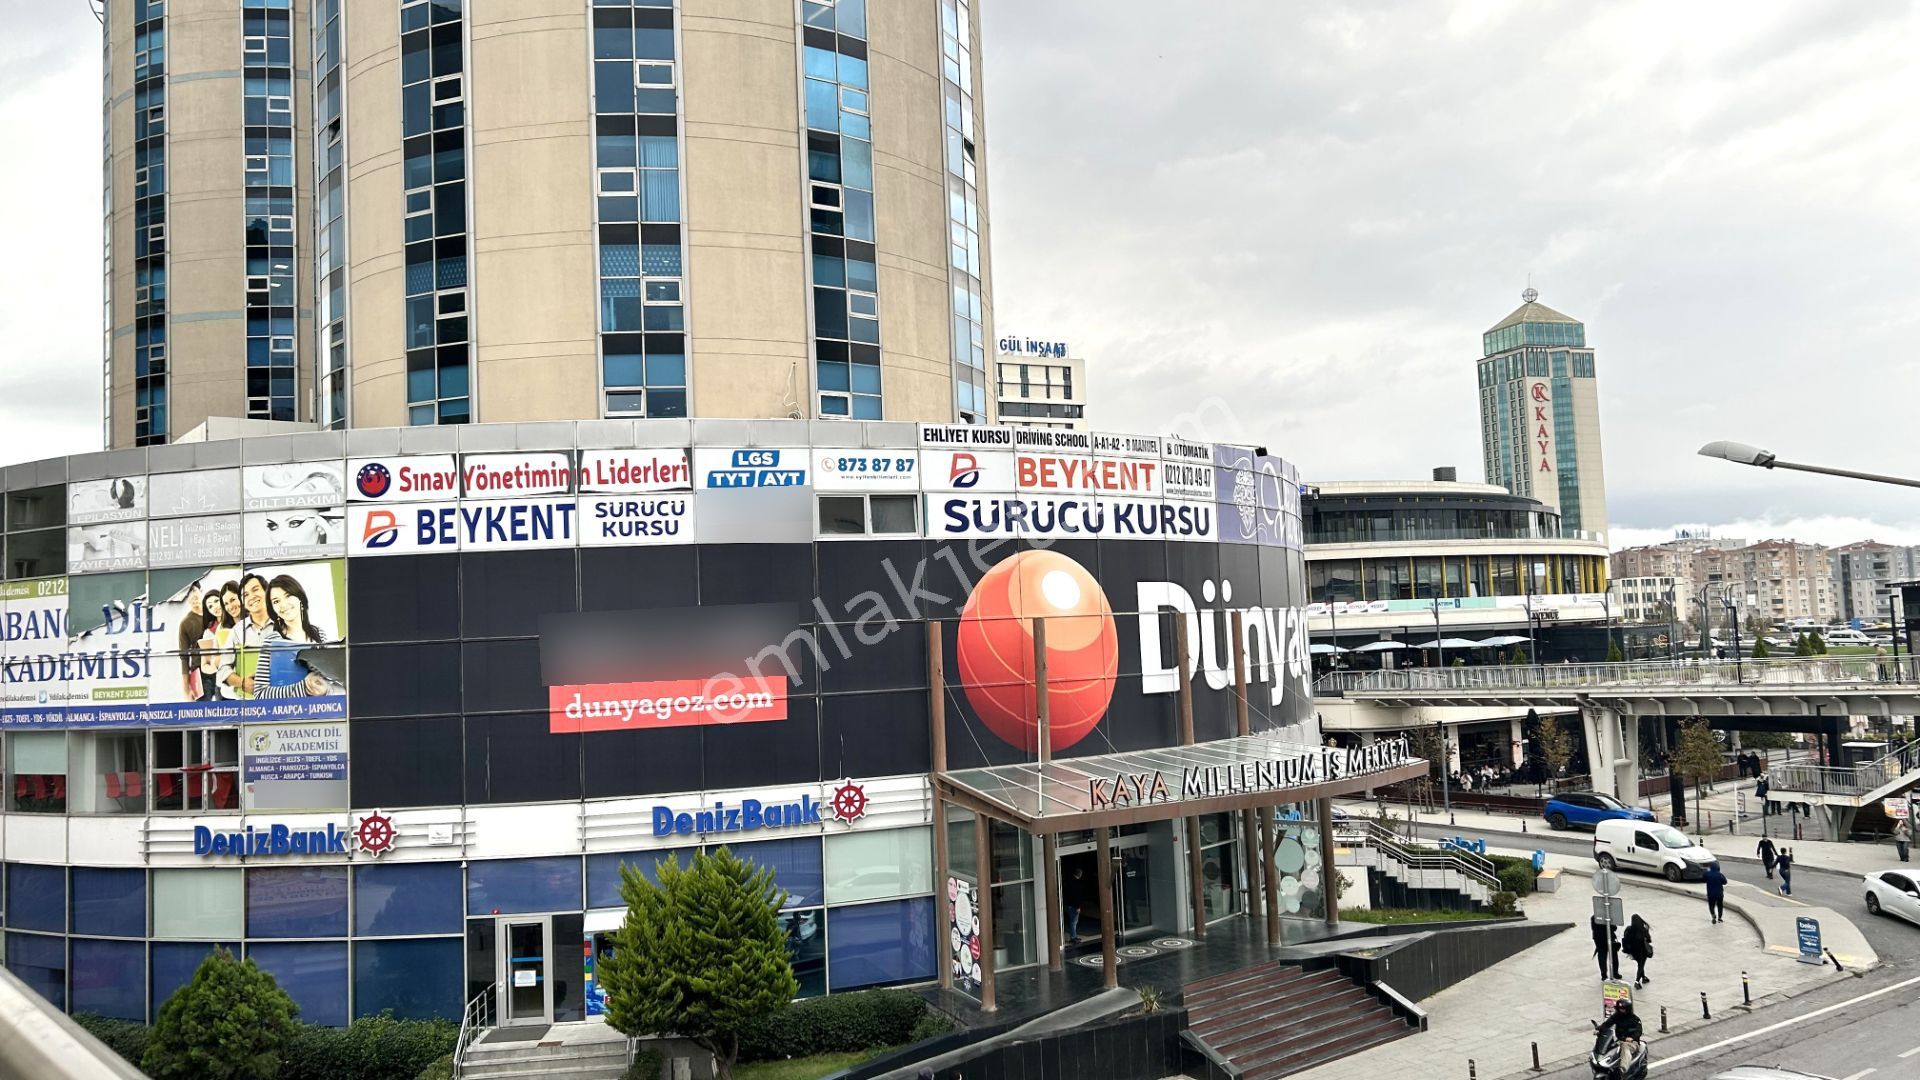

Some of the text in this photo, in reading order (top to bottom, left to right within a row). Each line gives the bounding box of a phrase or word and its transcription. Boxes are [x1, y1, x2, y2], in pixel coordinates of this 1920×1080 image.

[1000, 336, 1022, 352] GÜL
[923, 426, 968, 443] EHLİYET
[972, 429, 1010, 444] KURSU
[1055, 434, 1090, 448] SCHOOL
[1094, 436, 1120, 451] A-A1-A2
[1132, 438, 1158, 453] MANUEL
[1167, 443, 1172, 455] B
[1535, 406, 1552, 472] KAYA
[738, 452, 774, 466] LGS
[838, 458, 915, 472] 873 87 87
[400, 466, 456, 492] Sınav
[596, 456, 688, 486] Liderleri
[712, 471, 800, 486] TYT AYT
[1018, 456, 1156, 492] BEYKENT
[1165, 464, 1181, 484] 0212
[418, 504, 576, 546] BEYKENT
[602, 520, 680, 538] KURSU
[1114, 504, 1210, 536] KURSU
[178, 708, 203, 720] JUNIOR
[564, 691, 774, 721] dunyagoz.com
[276, 726, 342, 739] YABANCI DİL
[280, 740, 338, 752] AKADEMİSİ
[1090, 732, 1410, 806] KAYA MILLENIUM İŞ MERKEZİ
[652, 794, 822, 837] DenizBank
[194, 823, 346, 855] DenizBank
